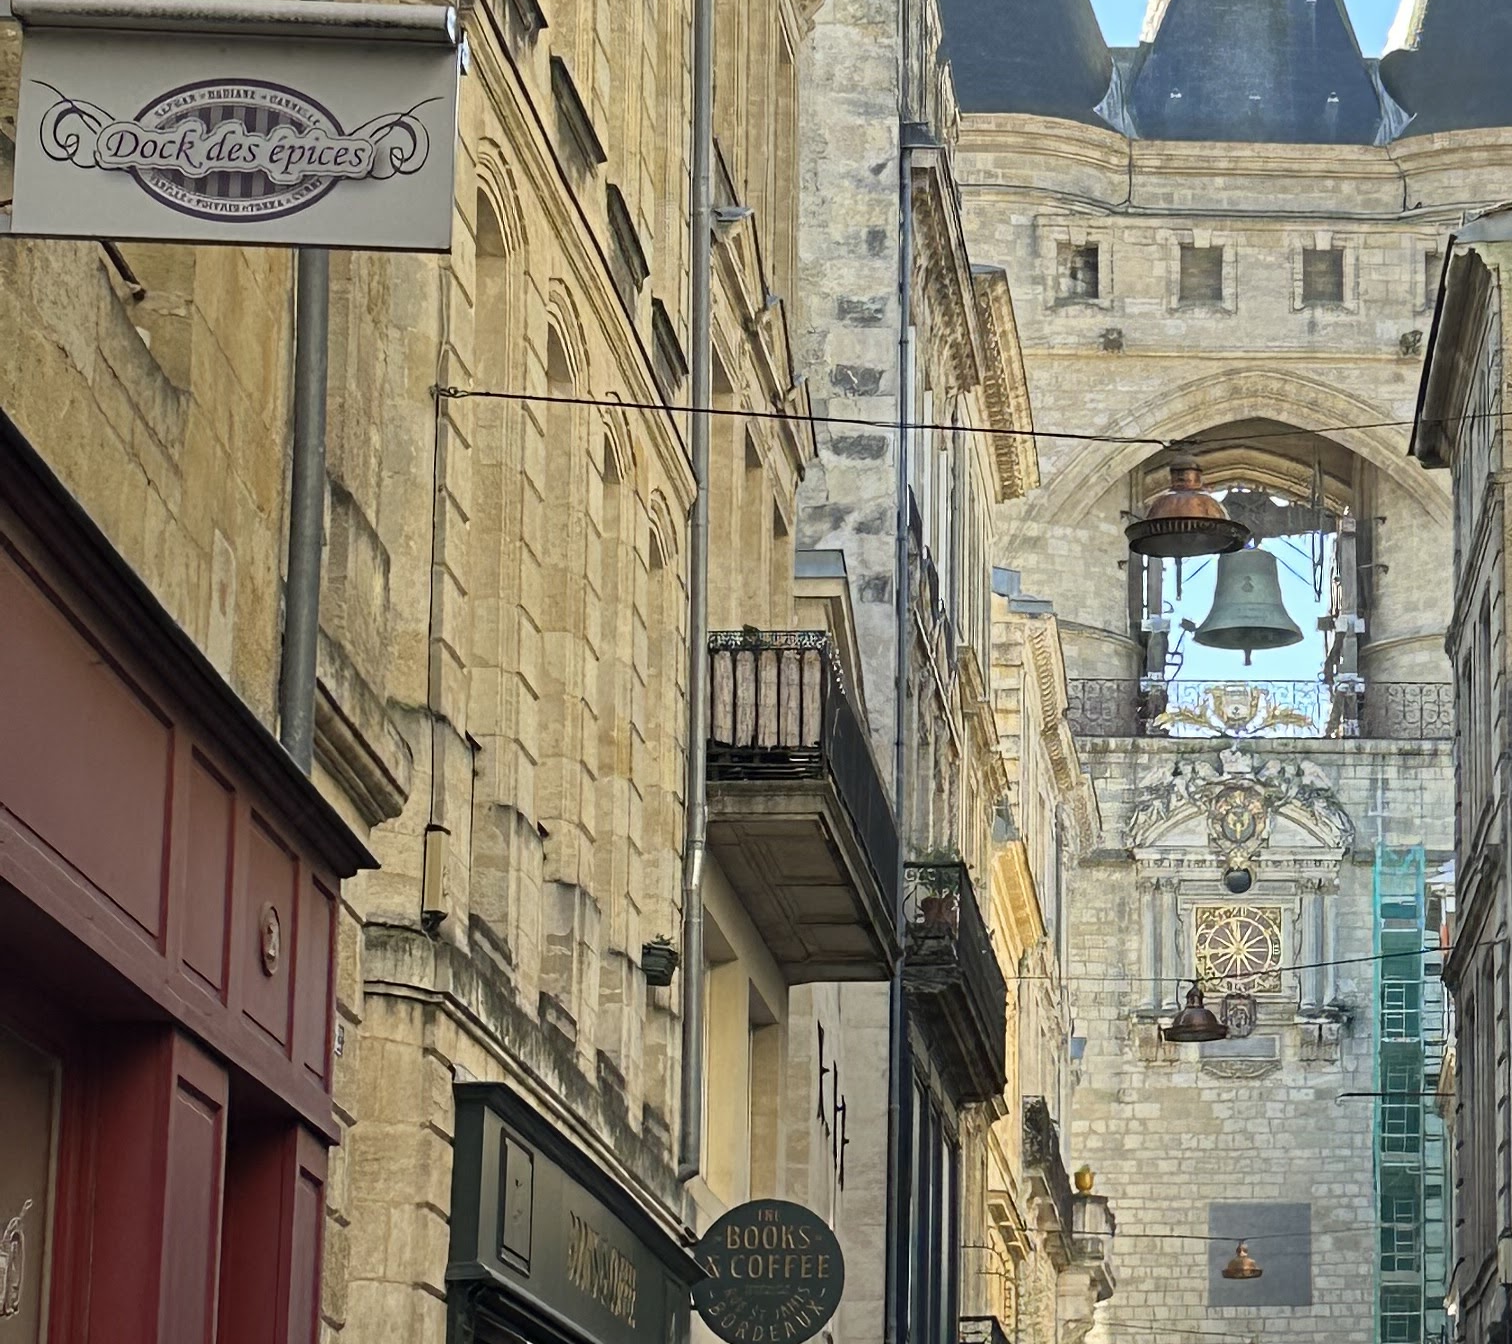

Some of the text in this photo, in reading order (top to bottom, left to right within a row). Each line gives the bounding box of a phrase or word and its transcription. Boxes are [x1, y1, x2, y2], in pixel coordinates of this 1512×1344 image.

[106, 129, 368, 174] Dock des épices
[726, 1224, 811, 1250] BOOKS
[730, 1254, 831, 1280] COFFEE
[708, 1298, 826, 1343] BORDEAUX
